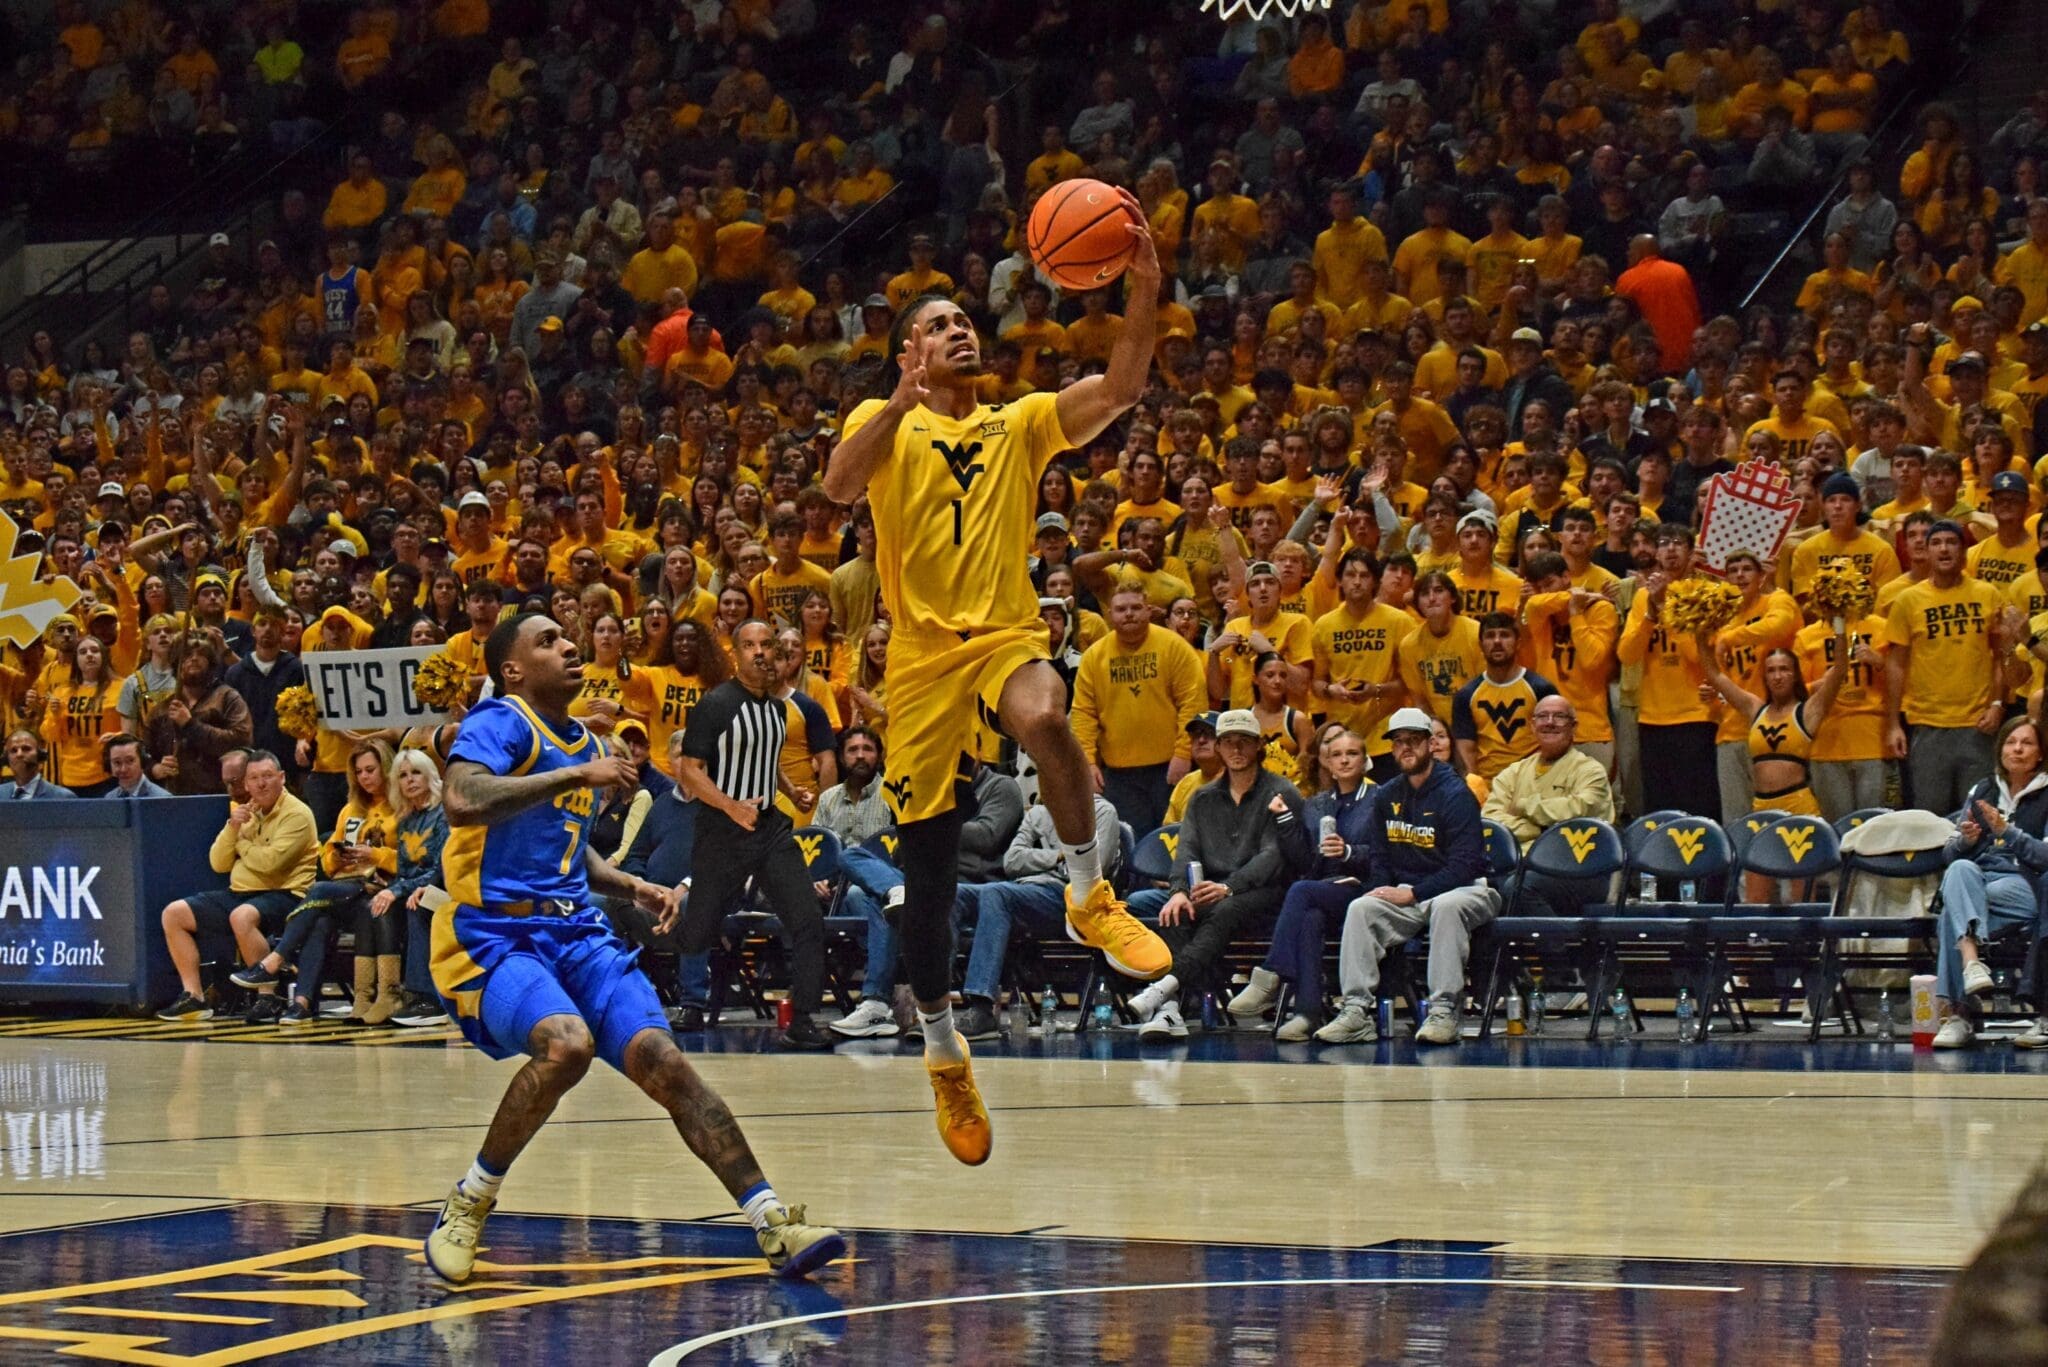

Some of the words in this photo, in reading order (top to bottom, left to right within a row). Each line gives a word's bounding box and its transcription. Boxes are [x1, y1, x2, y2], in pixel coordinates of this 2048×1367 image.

[326, 302, 345, 321] 44
[951, 499, 963, 546] 1
[1979, 558, 2026, 574] HODGE
[1924, 602, 1982, 624] BEAT
[1333, 628, 1386, 641] HODGE
[1927, 618, 1985, 640] PITT
[1333, 640, 1385, 654] SQUAD
[303, 661, 388, 719] LET'S
[68, 696, 105, 714] BEAT
[66, 714, 104, 737] PITT
[559, 819, 582, 876] 7
[0, 866, 103, 920] ANK
[51, 939, 105, 966] Bank
